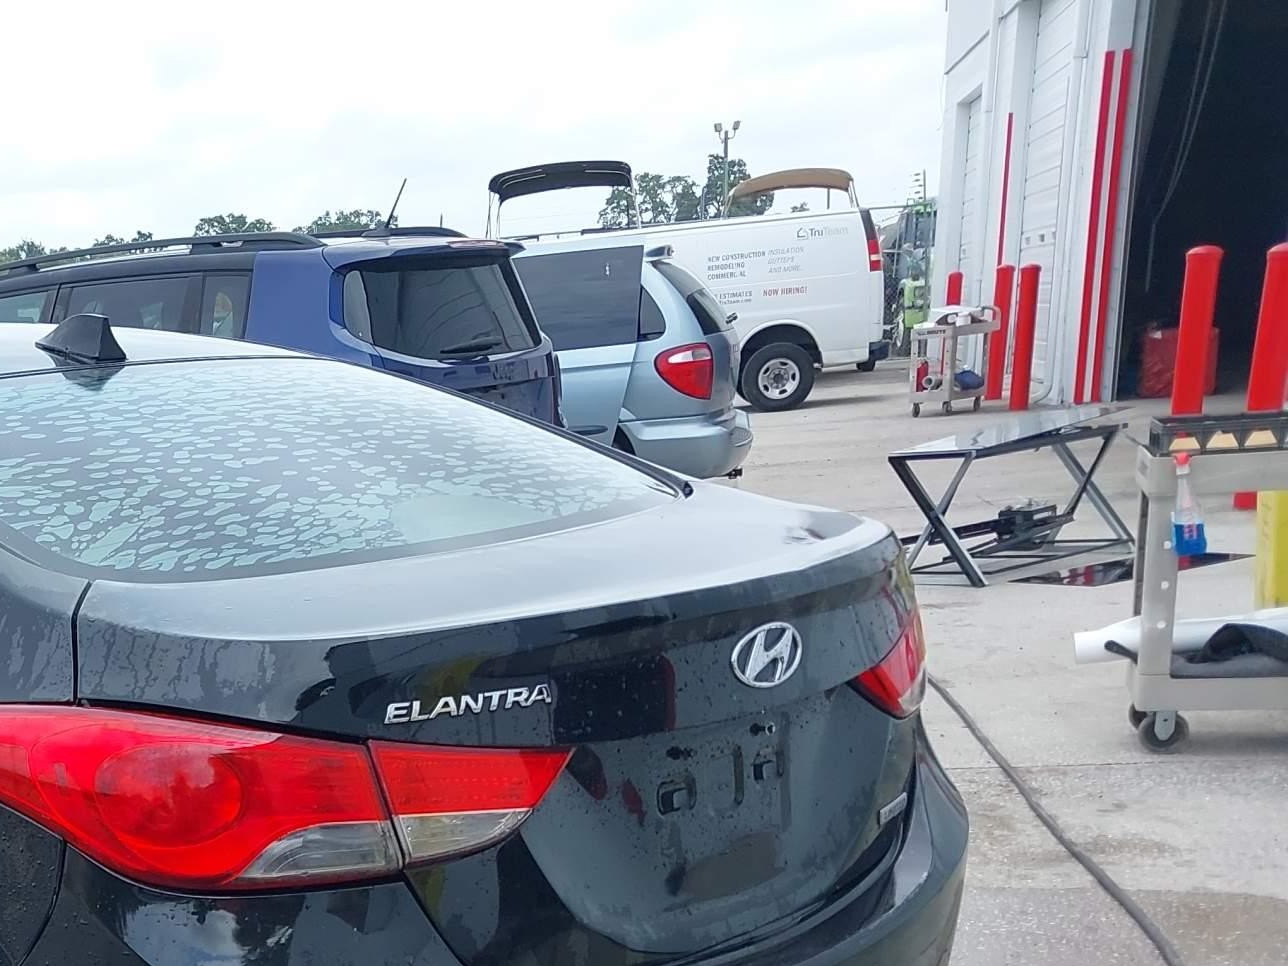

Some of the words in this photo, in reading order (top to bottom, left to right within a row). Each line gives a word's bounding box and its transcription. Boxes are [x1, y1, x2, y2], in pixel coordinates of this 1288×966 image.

[722, 250, 766, 262] CONSTRUCTION
[719, 290, 753, 300] ESTIMATES
[763, 288, 779, 297] NOW
[383, 683, 552, 725] ELANTRA
